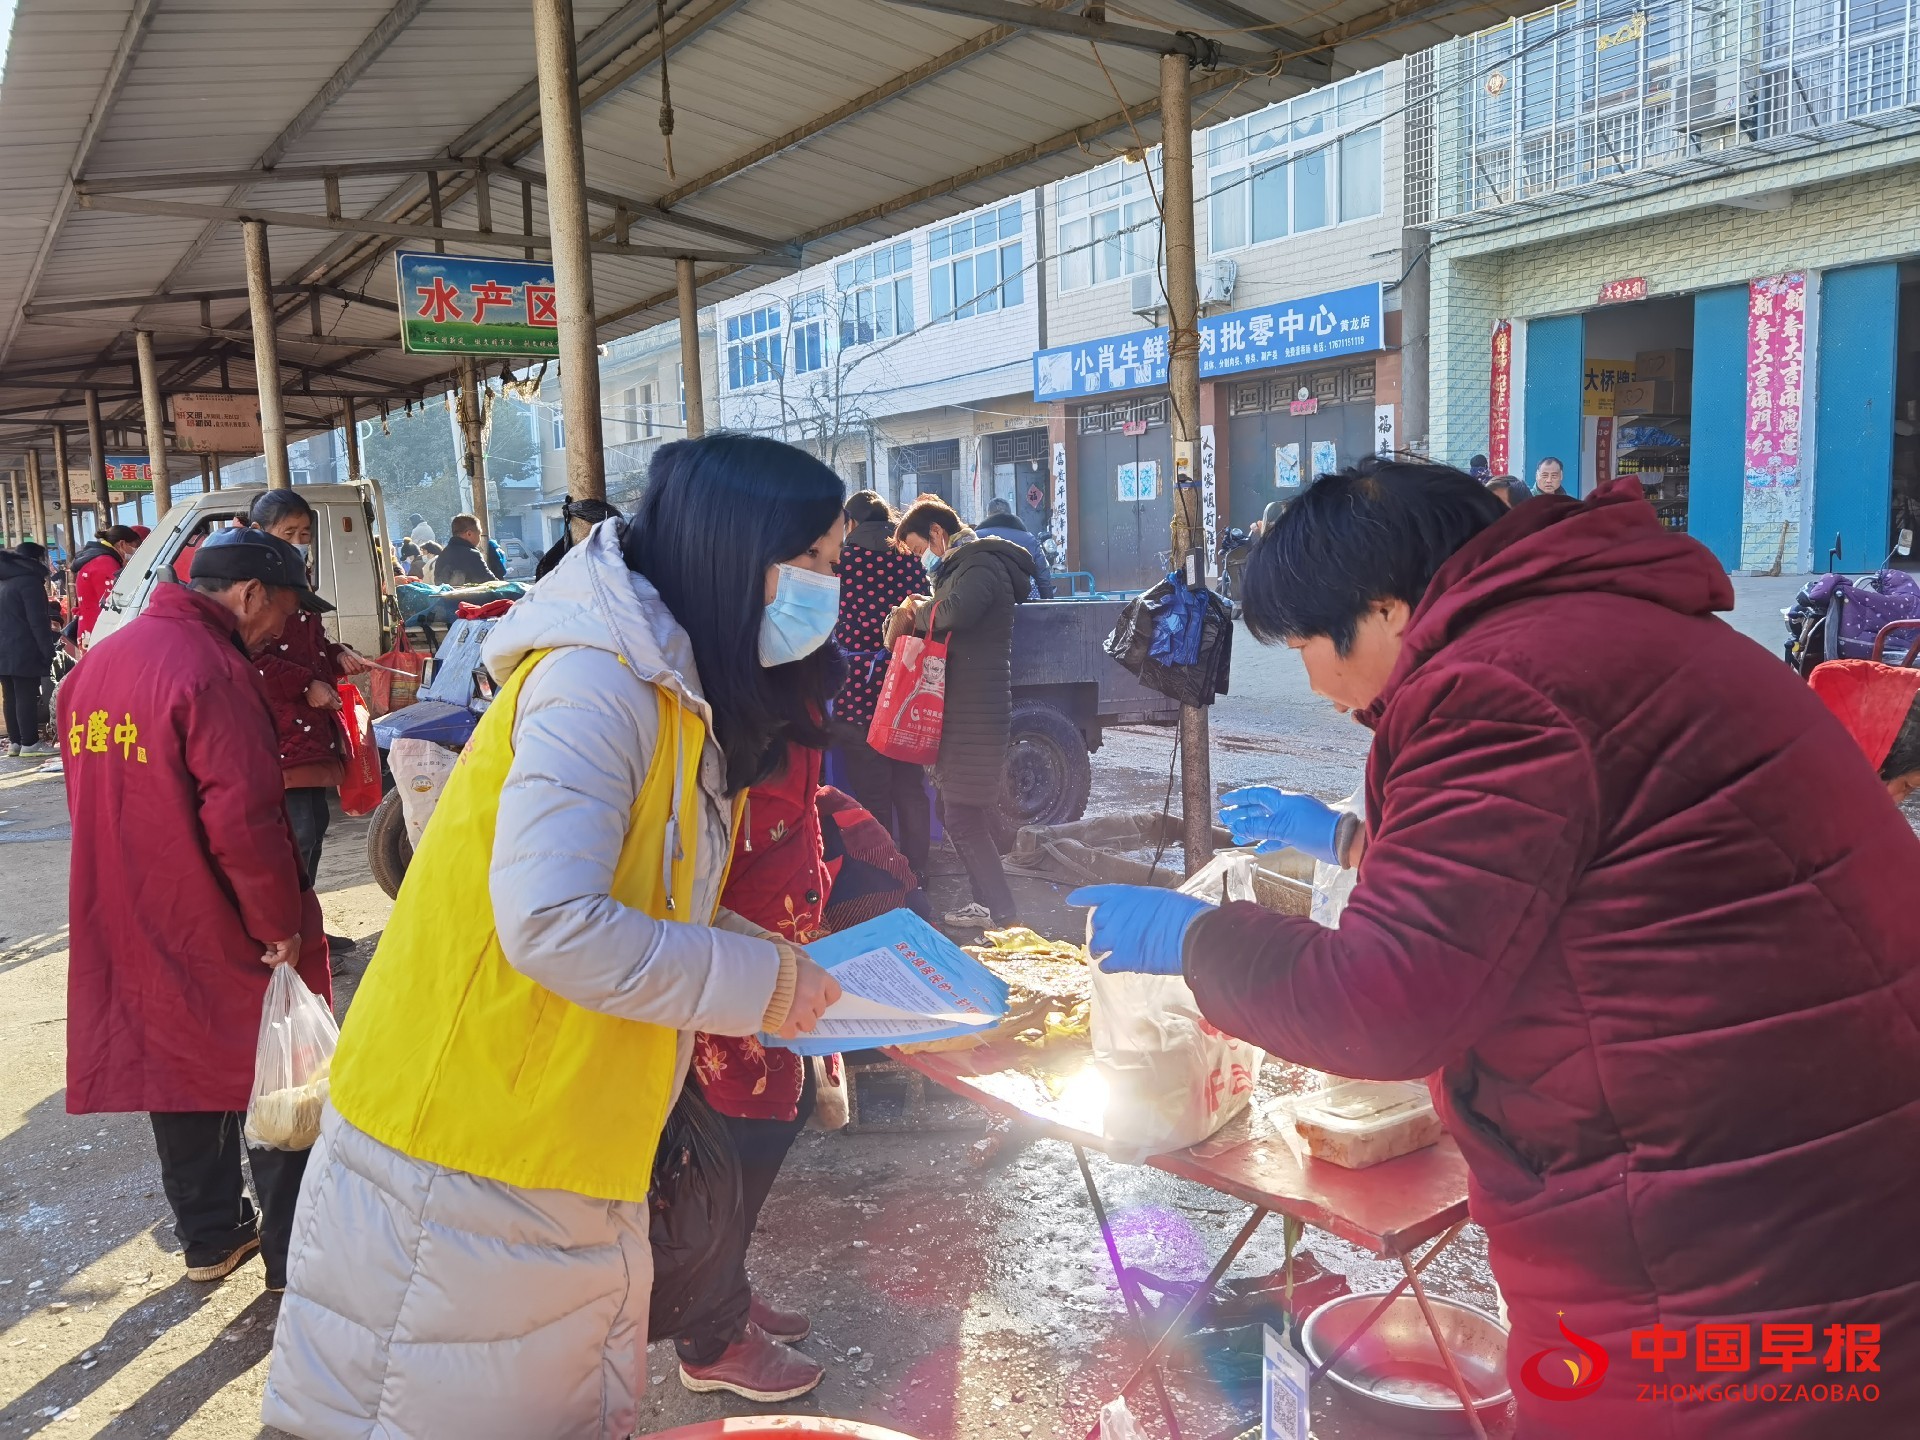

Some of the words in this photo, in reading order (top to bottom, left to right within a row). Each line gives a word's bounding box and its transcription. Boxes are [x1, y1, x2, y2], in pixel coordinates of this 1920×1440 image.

[416, 277, 558, 327] 水产区
[1339, 315, 1370, 332] 黄龙店
[1074, 303, 1337, 377] 小肖生鲜肉批零中心
